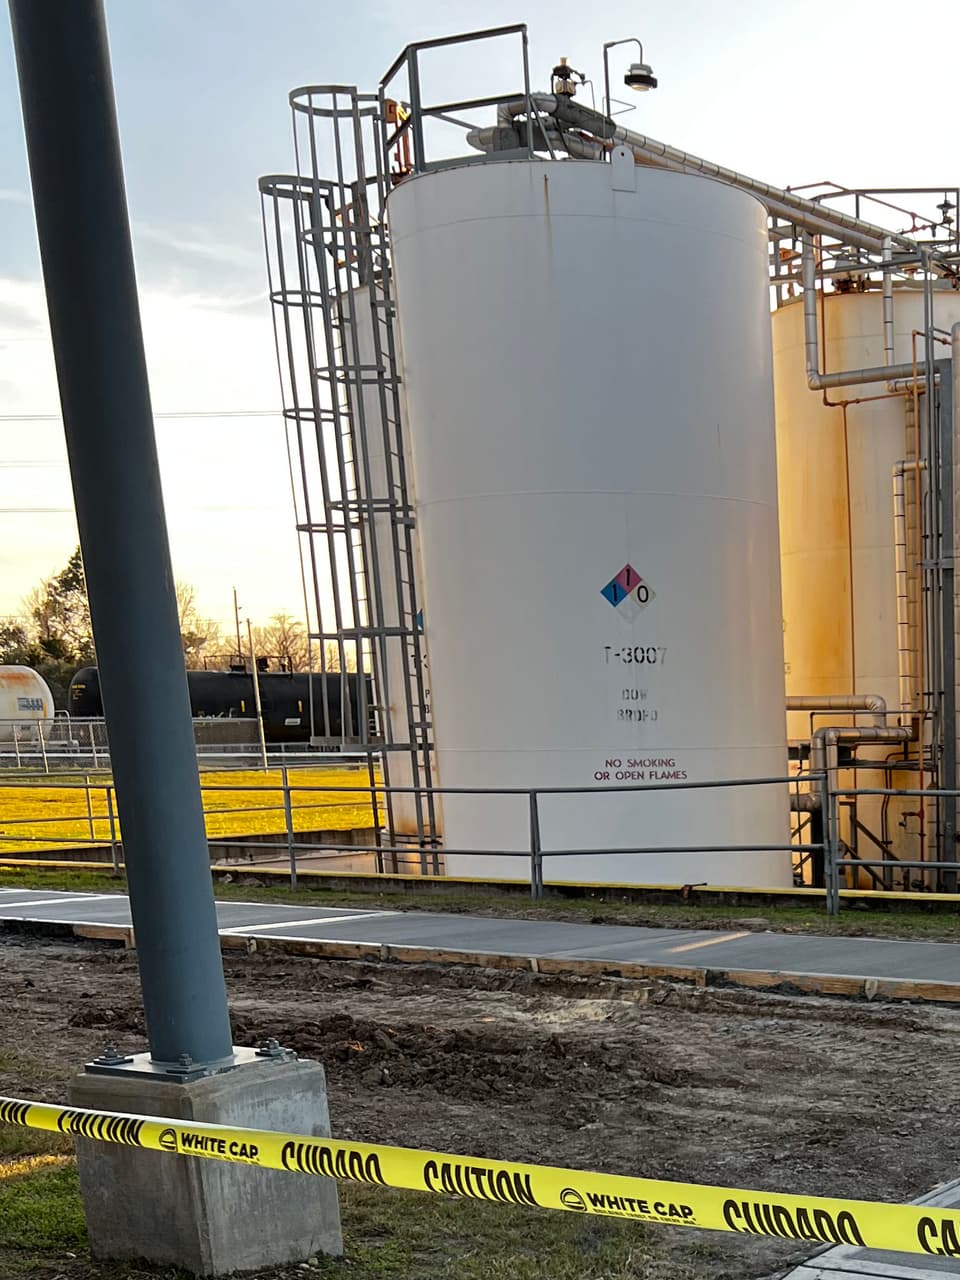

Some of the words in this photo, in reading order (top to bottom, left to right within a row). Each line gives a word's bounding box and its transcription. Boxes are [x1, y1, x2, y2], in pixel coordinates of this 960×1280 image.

[626, 568, 631, 586] 1
[612, 584, 618, 602] 1
[637, 585, 649, 603] 0
[604, 646, 667, 664] T-3007
[594, 771, 610, 781] OR
[615, 771, 644, 781] OPEN
[649, 770, 688, 780] FLAMES
[605, 759, 622, 768] NO
[627, 759, 676, 768] SMOKING
[57, 1109, 146, 1146] CAUTION
[181, 1132, 226, 1154] WHITE
[229, 1141, 258, 1159] CAP
[281, 1141, 388, 1186] CUIDADO
[424, 1160, 538, 1206] CAUTION
[586, 1192, 651, 1214] WHITE
[653, 1202, 693, 1219] CAP
[723, 1199, 867, 1247] CUIDADO
